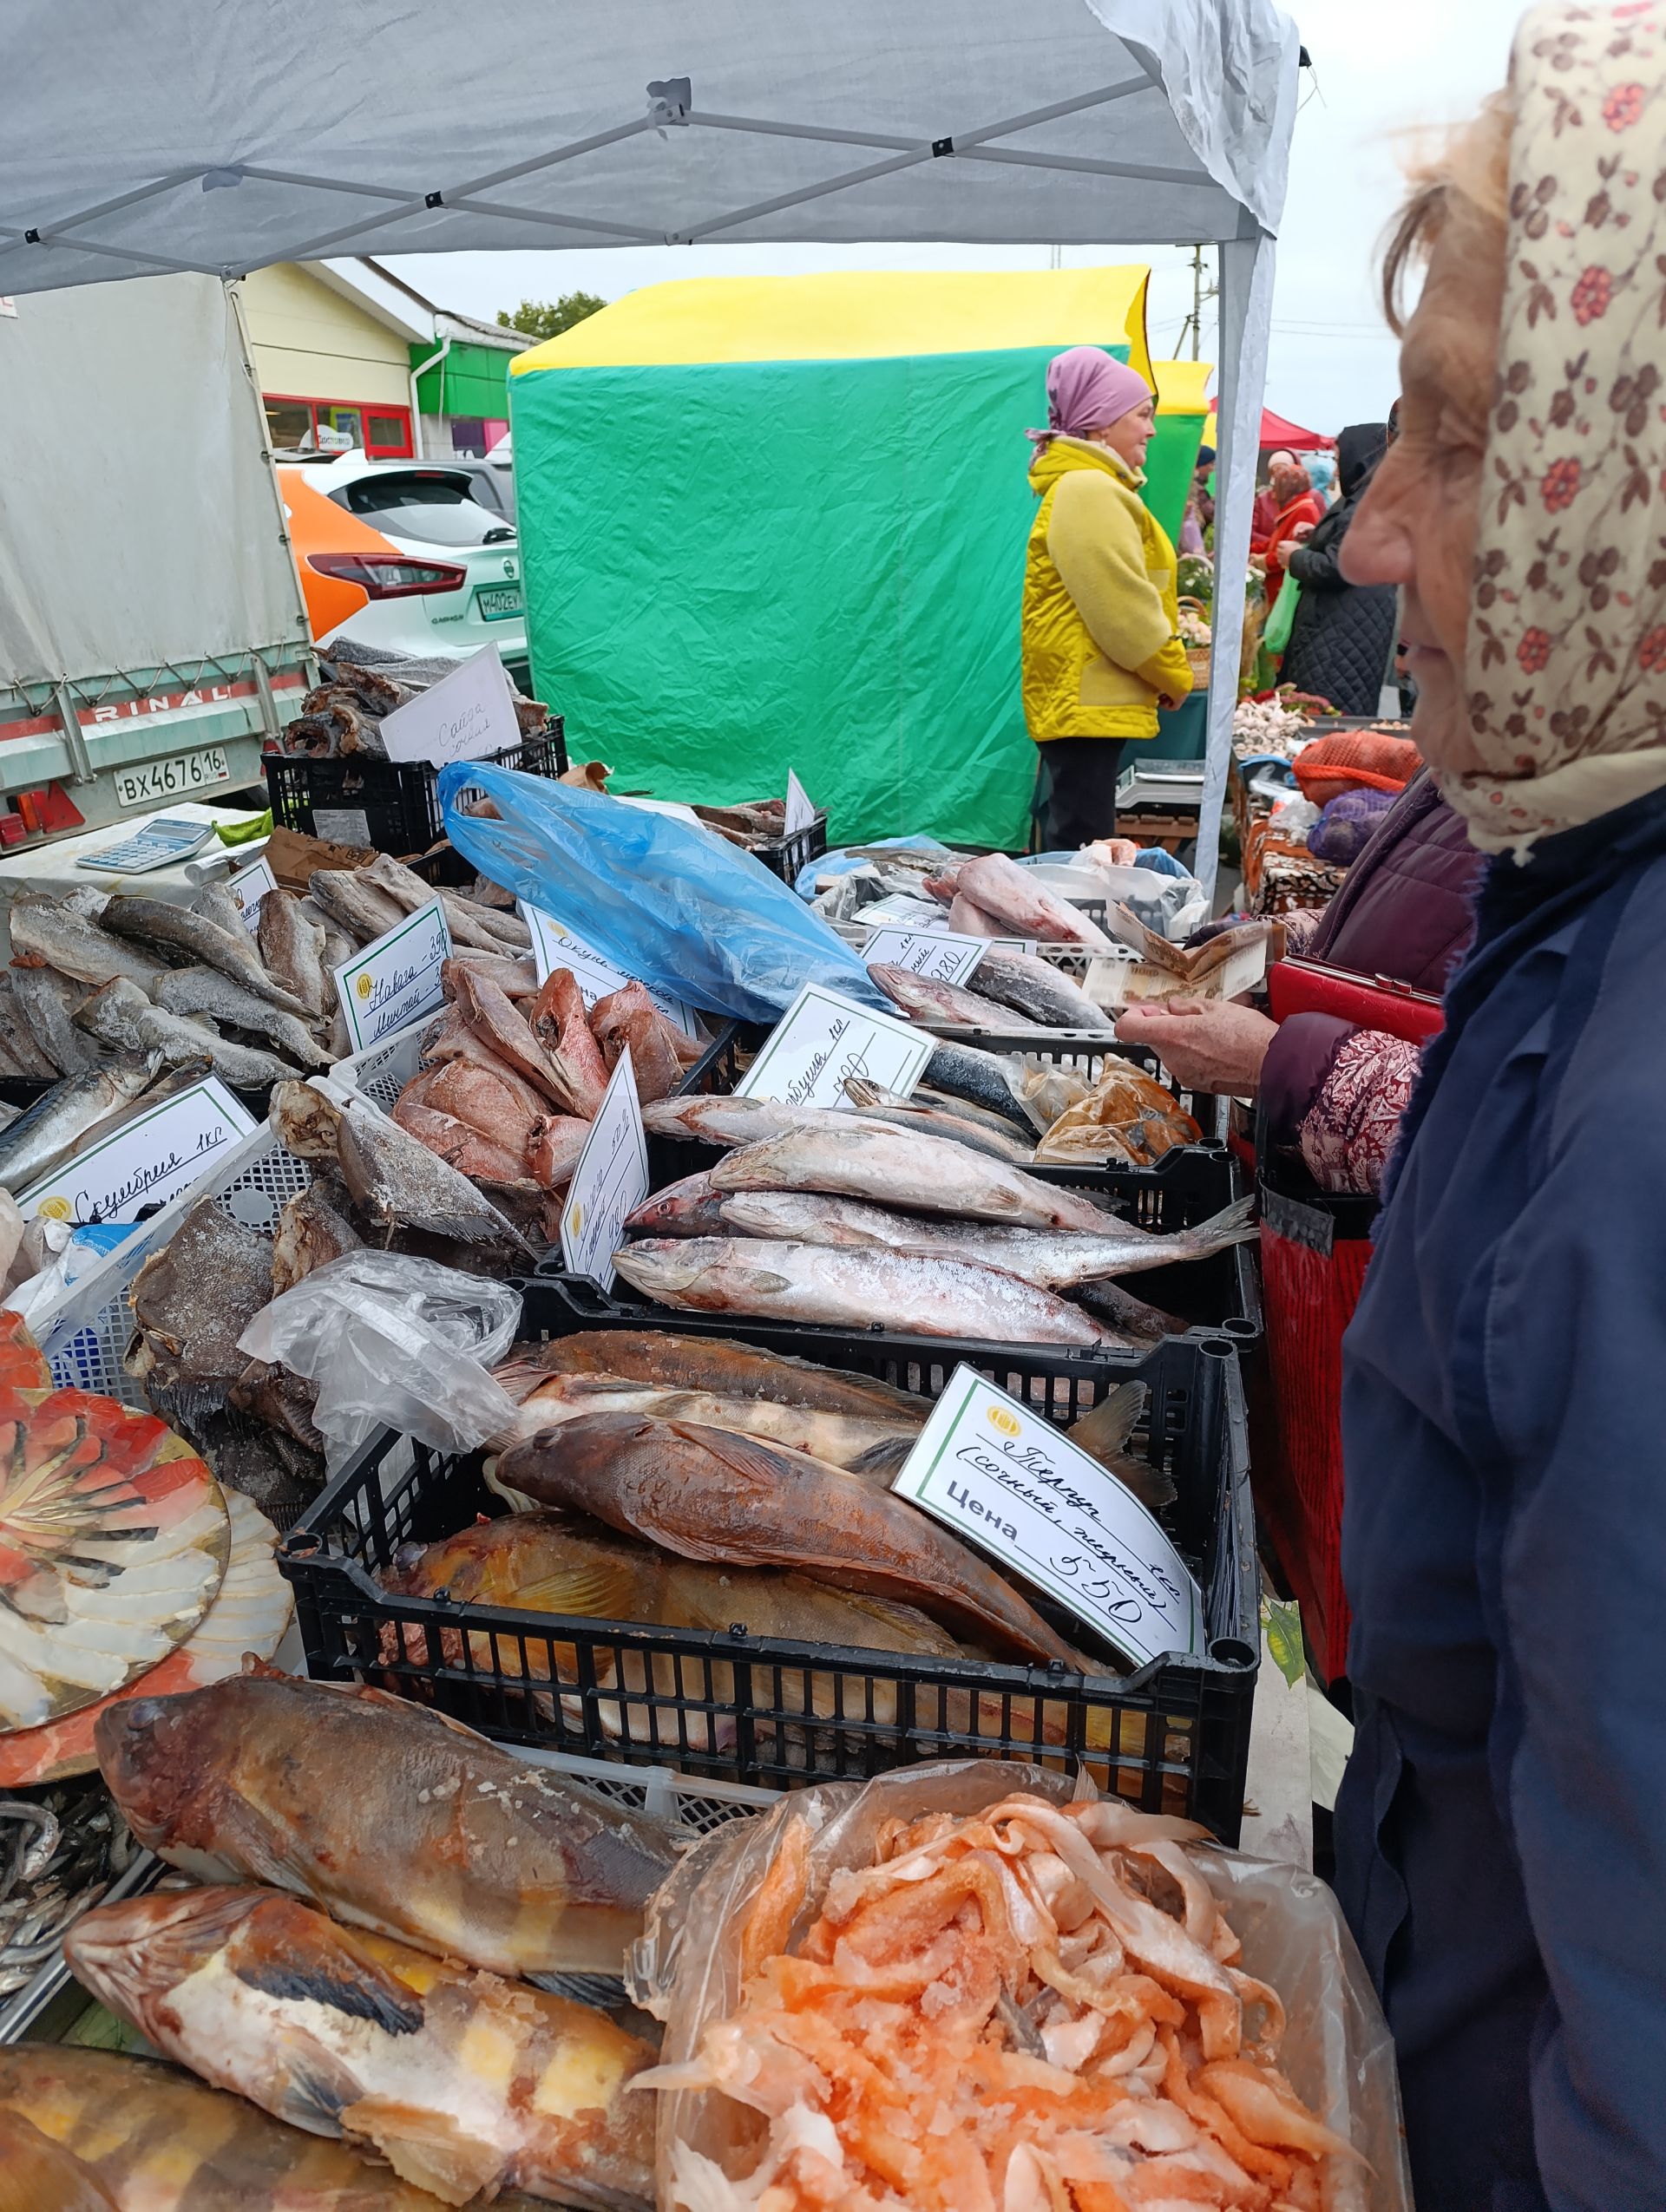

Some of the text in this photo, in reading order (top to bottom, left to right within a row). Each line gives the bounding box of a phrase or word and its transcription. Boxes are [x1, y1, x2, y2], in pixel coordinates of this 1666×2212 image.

[204, 749, 221, 772] 16
[1003, 1441, 1102, 1522] Терпуг
[946, 1479, 1143, 1623] Цена 550
